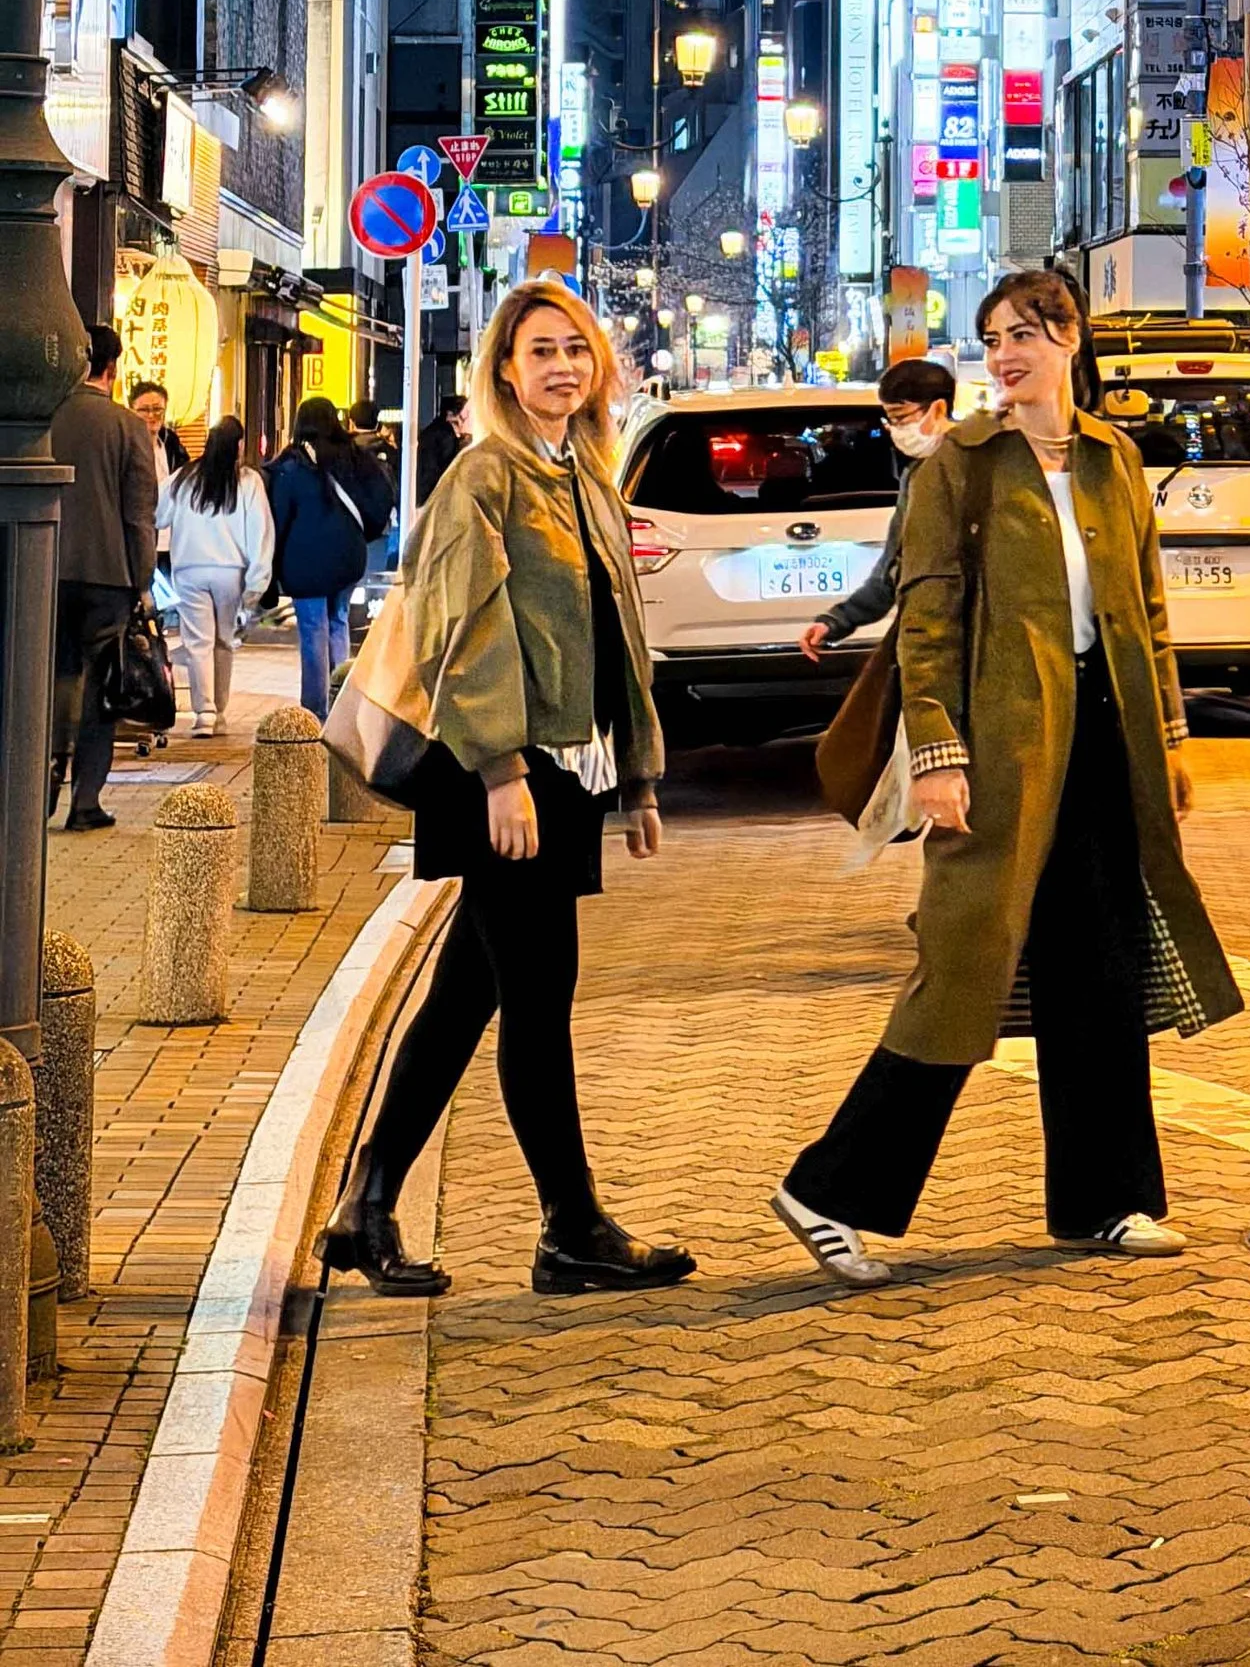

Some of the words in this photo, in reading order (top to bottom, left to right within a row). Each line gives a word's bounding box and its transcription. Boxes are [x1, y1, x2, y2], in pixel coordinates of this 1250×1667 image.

[848, 55, 867, 114] HOTEL
[484, 91, 528, 111] Still
[498, 129, 529, 140] Violet
[943, 116, 975, 139] 82
[450, 140, 480, 152] 止まれ
[455, 153, 477, 163] STOP
[781, 571, 843, 594] 61-89
[1184, 566, 1233, 585] 13-59
